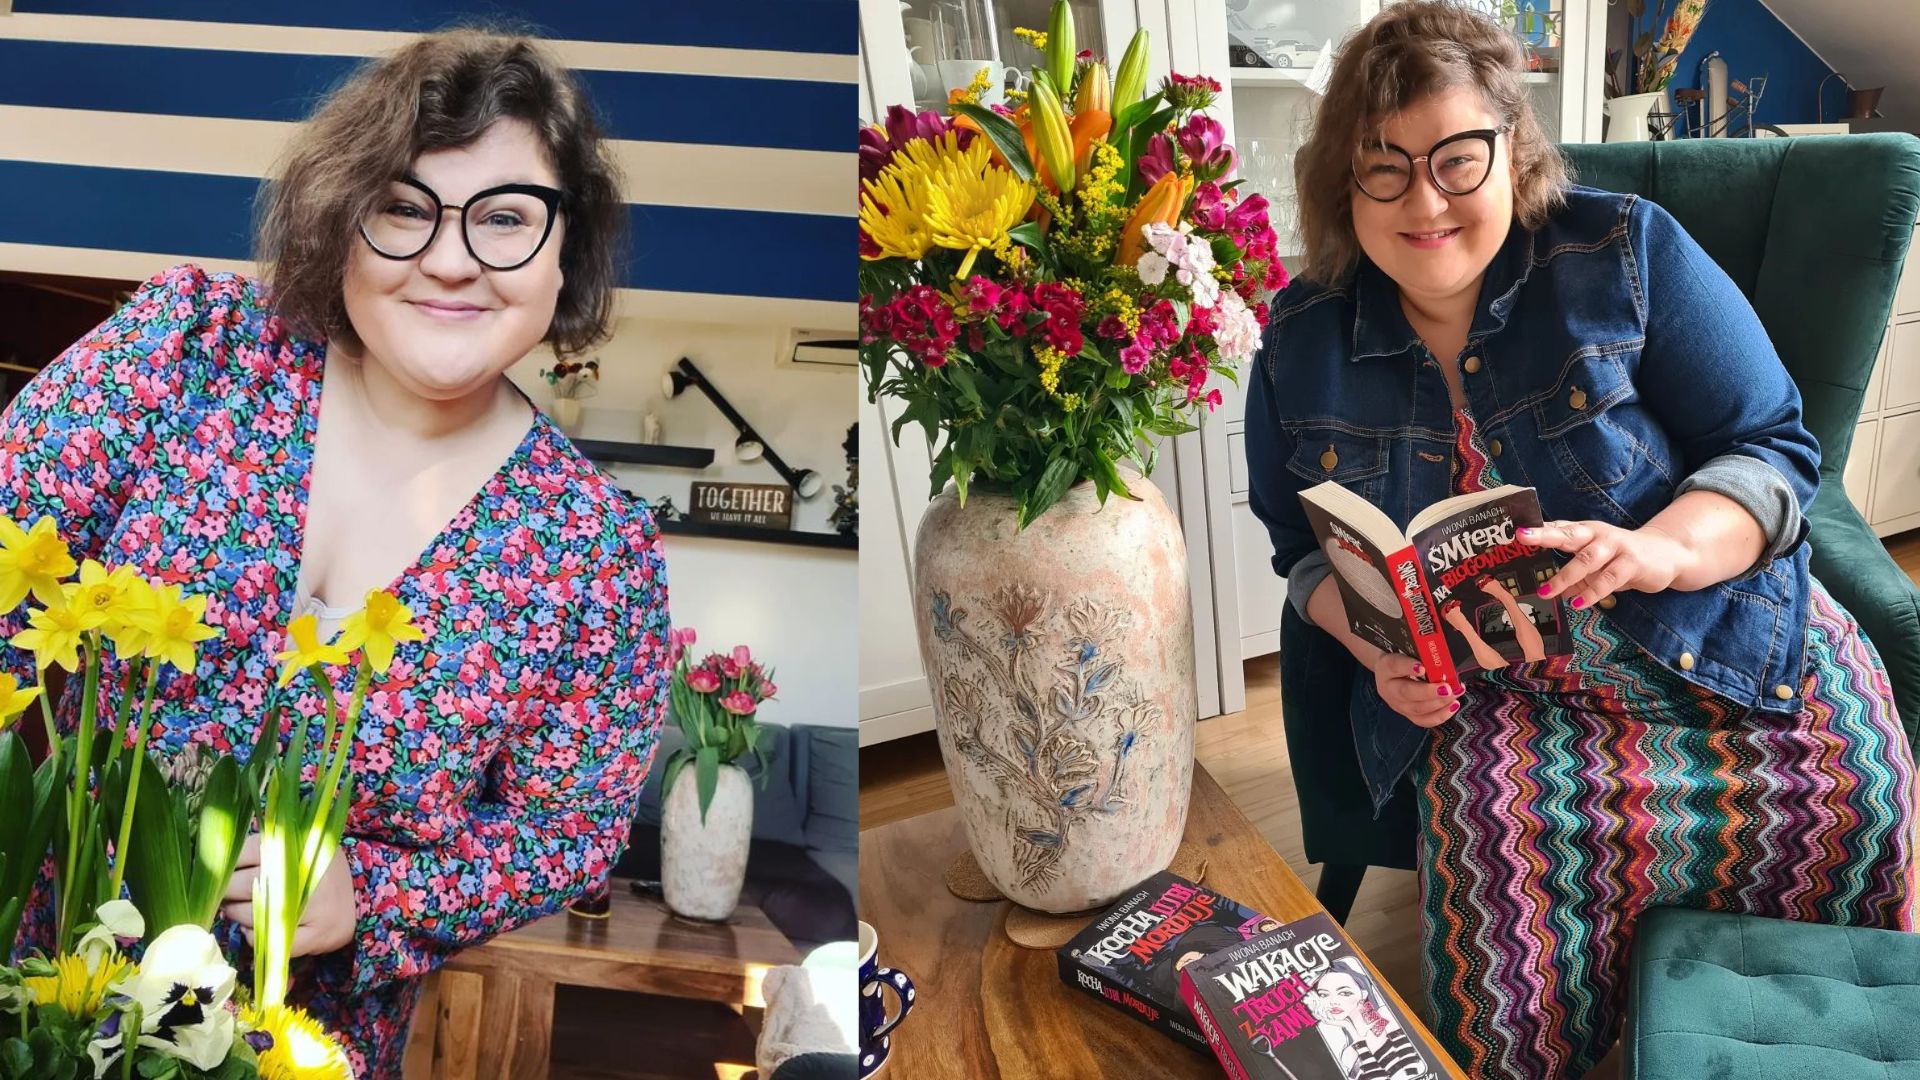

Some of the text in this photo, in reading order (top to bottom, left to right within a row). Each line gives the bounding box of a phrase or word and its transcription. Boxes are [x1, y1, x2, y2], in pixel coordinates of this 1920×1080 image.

[697, 486, 785, 513] TOGETHER
[710, 512, 720, 521] WE
[722, 513, 741, 522] HAVE
[744, 514, 752, 523] IT
[1441, 506, 1504, 536] IWONA BANACH
[1432, 584, 1453, 604] NA
[1096, 890, 1151, 932] IWONA BANACH
[1085, 910, 1168, 966] KOCHA,
[1228, 929, 1296, 962] IWONA BANACH
[1232, 972, 1311, 1025] TRUCH
[1238, 1019, 1259, 1039] Z
